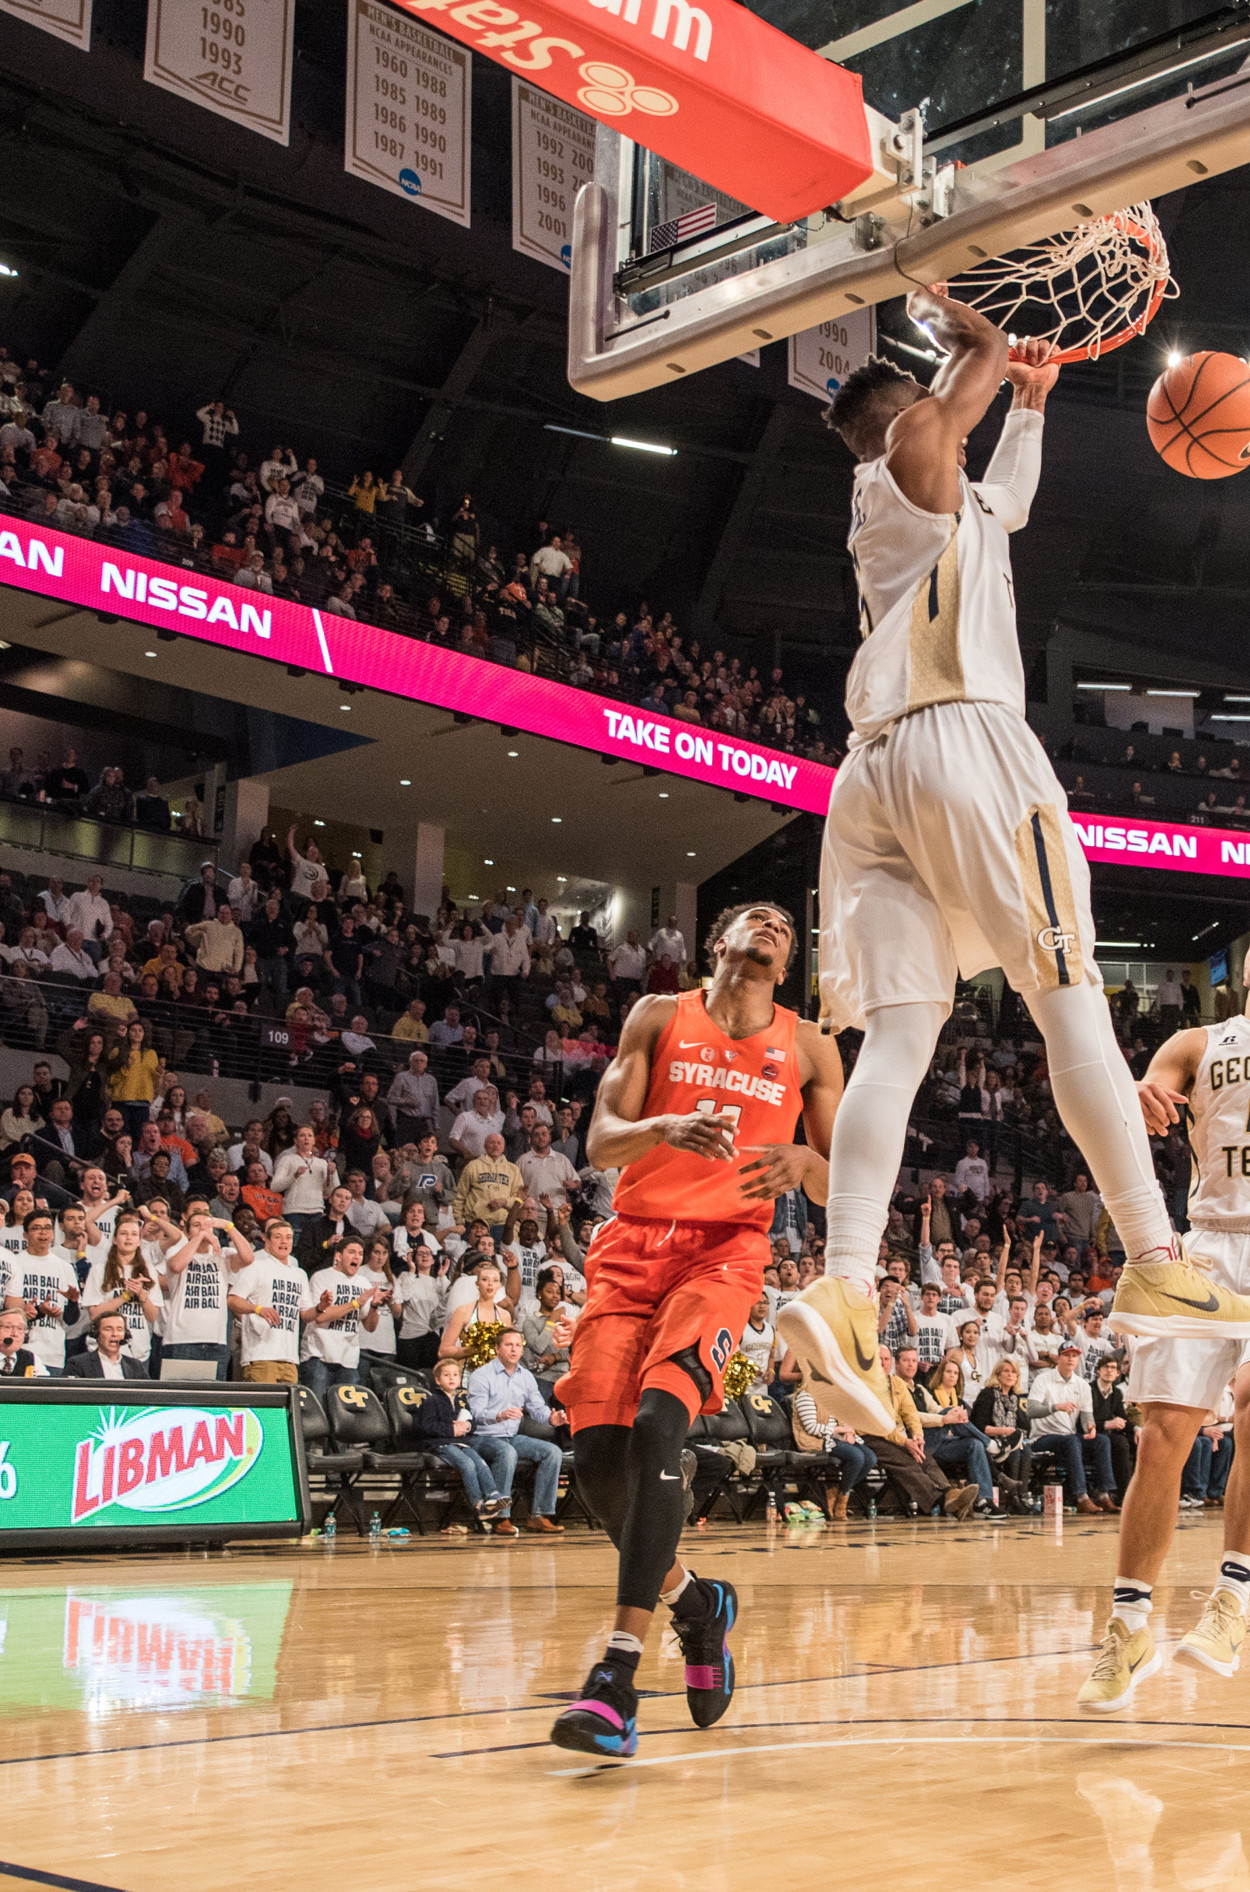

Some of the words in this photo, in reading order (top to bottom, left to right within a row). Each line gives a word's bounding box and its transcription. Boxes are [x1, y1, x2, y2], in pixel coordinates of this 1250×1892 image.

[201, 7, 246, 47] 1990
[399, 20, 455, 62] BASKETBALL
[405, 0, 586, 71] Sta
[200, 36, 243, 76] 1993
[369, 23, 392, 44] NCAA
[395, 37, 454, 77] APPEARANCES
[194, 71, 251, 102] ACC
[375, 46, 408, 78] 1960
[415, 67, 447, 99] 1988
[374, 74, 407, 106] 1985
[415, 94, 447, 126] 1989
[374, 103, 407, 134] 1986
[414, 122, 447, 154] 1990
[530, 108, 550, 128] NCAA
[374, 131, 405, 161] 1987
[414, 151, 444, 181] 1991
[536, 131, 565, 159] 1992
[572, 149, 595, 175] 200
[536, 157, 565, 185] 1993
[537, 183, 567, 213] 1996
[537, 210, 568, 239] 2001
[819, 321, 848, 347] 1990
[100, 561, 273, 650] NISSAN
[603, 708, 671, 754] TAKE
[674, 731, 714, 766] ON
[717, 743, 798, 790] TODAY
[1072, 822, 1198, 859] NISSAN
[1037, 925, 1076, 955] GT
[268, 1030, 290, 1045] 109
[668, 1060, 787, 1107] SYRACUSE
[4, 1239, 20, 1250] AIR
[22, 1287, 38, 1300] AIR
[23, 1274, 38, 1286] AIR
[40, 1275, 59, 1290] BALL
[185, 1285, 199, 1298] AIR
[201, 1286, 219, 1298] BALL
[186, 1273, 201, 1285] AIR
[201, 1275, 219, 1285] BALL
[272, 1279, 285, 1290] AIR
[286, 1281, 302, 1295] BALL
[337, 1284, 350, 1296] AIR
[184, 1298, 199, 1309] AIR
[201, 1298, 219, 1310] BALL
[272, 1291, 285, 1304] AIR
[918, 1328, 931, 1337] AIR
[931, 1328, 943, 1338] BALL
[919, 1337, 930, 1347] AIR
[710, 1327, 733, 1375] S
[338, 1386, 369, 1408] GT
[398, 1387, 428, 1409] GT
[750, 1395, 773, 1414] GT
[73, 1412, 245, 1519] LIBMAN
